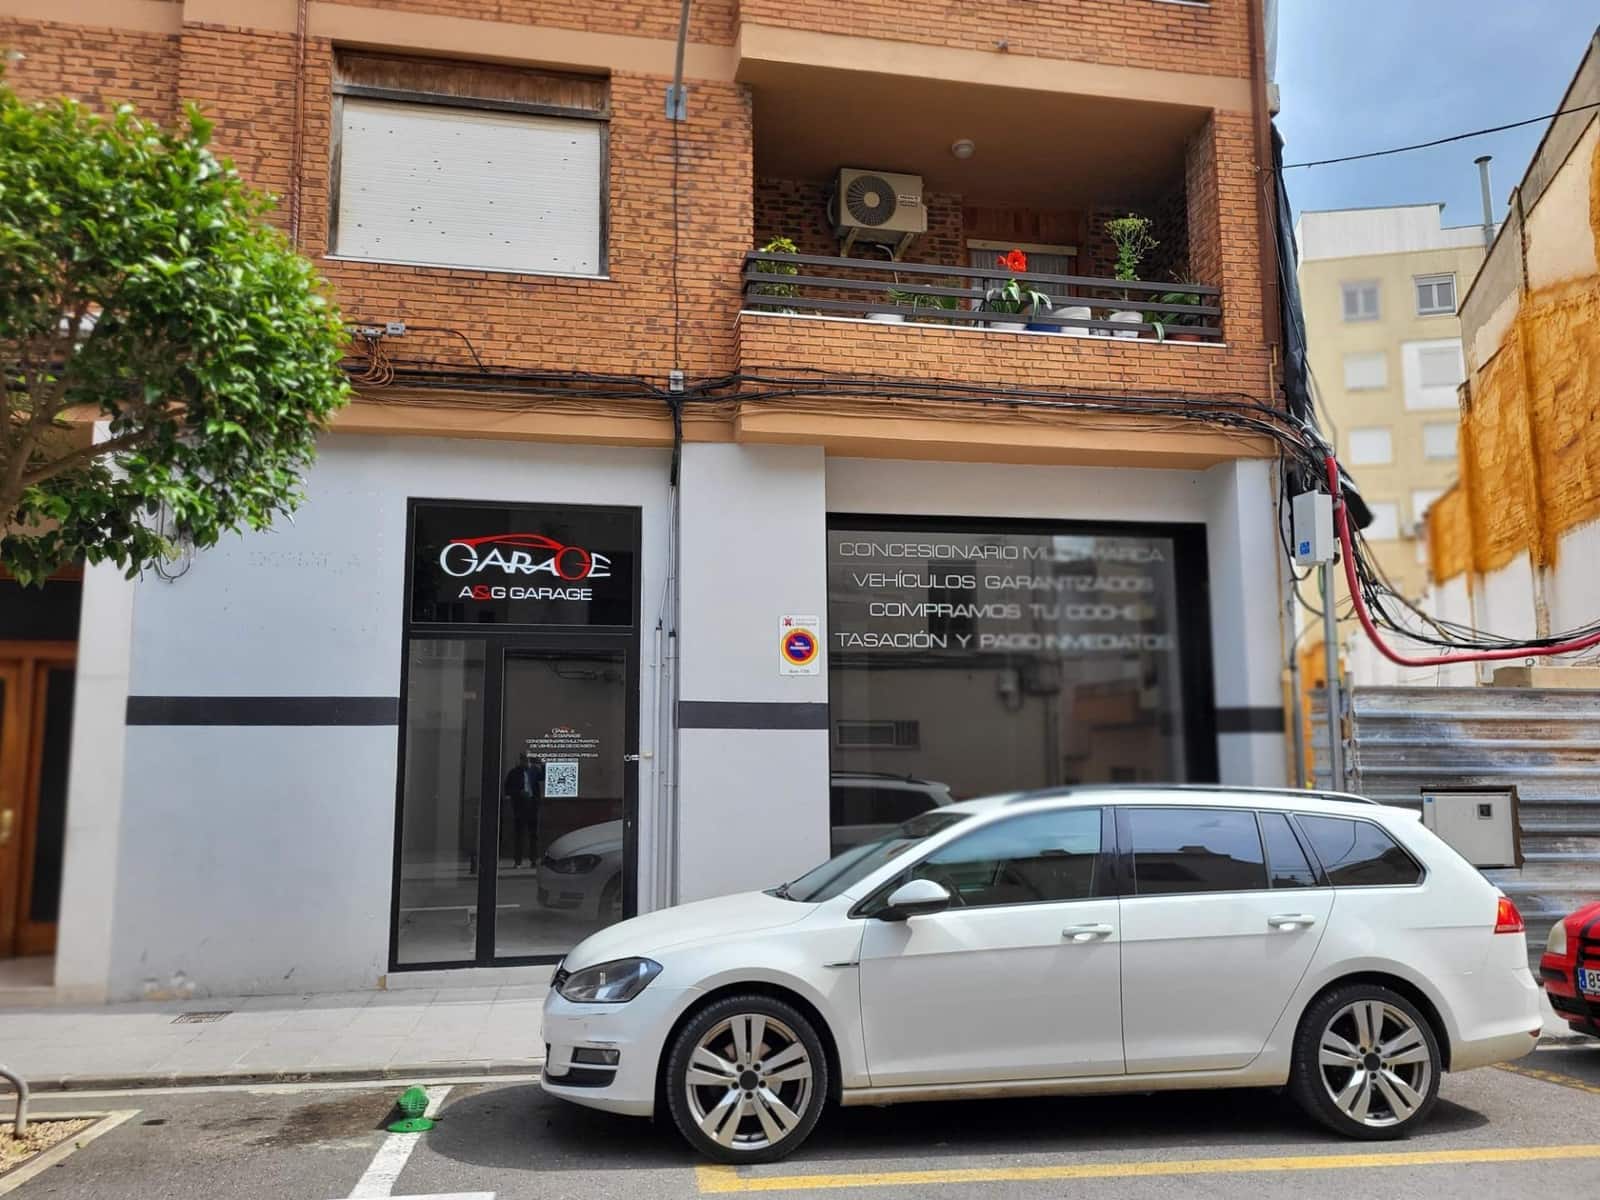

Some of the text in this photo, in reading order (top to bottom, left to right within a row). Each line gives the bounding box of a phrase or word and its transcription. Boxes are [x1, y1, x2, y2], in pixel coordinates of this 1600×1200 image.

[440, 543, 611, 580] GARAGE
[839, 542, 1166, 562] CONCESIONARIO MUMARCA
[853, 569, 976, 589] VEHÍCULOS
[458, 585, 592, 601] A&G GARAGE
[869, 602, 1022, 620] COMPRAMOS
[1029, 603, 1060, 620] TU
[835, 630, 947, 648] TASACIÓN
[956, 634, 972, 649] Y
